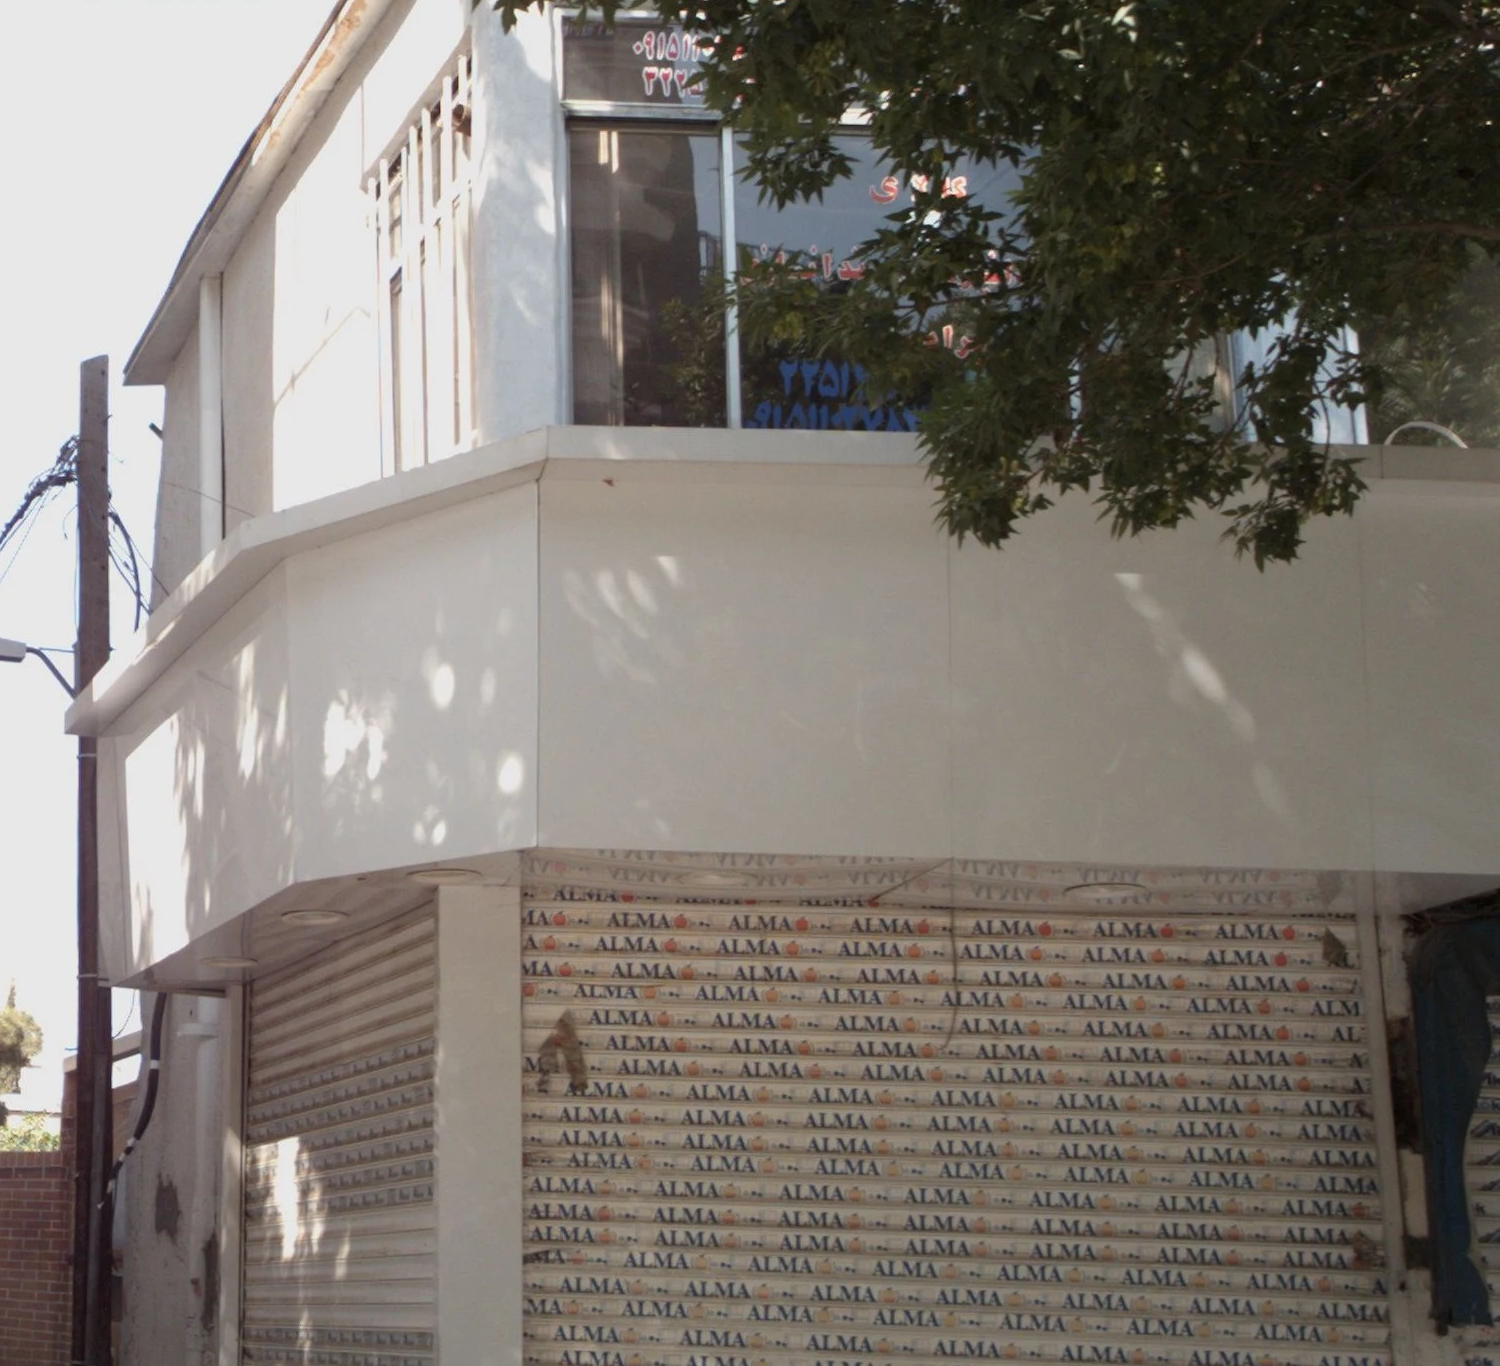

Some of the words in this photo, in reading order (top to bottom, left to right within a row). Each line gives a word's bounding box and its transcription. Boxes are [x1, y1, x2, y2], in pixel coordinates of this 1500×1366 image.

[971, 919, 1034, 936] ALMA
[1093, 921, 1156, 939] ALMA
[1215, 923, 1278, 940] ALMA
[596, 936, 658, 953] ALMA
[960, 943, 1023, 961] ALMA
[1082, 947, 1145, 963] ALMA
[612, 962, 676, 980] ALMA
[980, 970, 1044, 988] ALMA
[1102, 973, 1166, 991] ALMA
[1226, 975, 1290, 993] ALMA
[696, 985, 759, 1001] ALMA
[1064, 993, 1126, 1011] ALMA
[1187, 997, 1251, 1015] ALMA
[712, 1012, 776, 1030] ALMA
[836, 1015, 900, 1033] ALMA
[960, 1018, 1024, 1036] ALMA
[1084, 1021, 1148, 1039] ALMA
[853, 1041, 917, 1059] ALMA
[976, 1043, 1040, 1061] ALMA
[1100, 1046, 1164, 1064] ALMA
[619, 1059, 680, 1076] ALMA
[740, 1061, 802, 1079] ALMA
[862, 1064, 924, 1082] ALMA
[983, 1067, 1047, 1085] ALMA
[810, 1087, 874, 1105] ALMA
[932, 1090, 994, 1107] ALMA
[1054, 1093, 1118, 1110] ALMA
[1178, 1097, 1242, 1115] ALMA
[560, 1106, 622, 1124] ALMA
[682, 1109, 746, 1127] ALMA
[804, 1113, 868, 1131] ALMA
[928, 1115, 992, 1133] ALMA
[559, 1130, 623, 1148] ALMA
[684, 1133, 748, 1151] ALMA
[808, 1137, 872, 1155] ALMA
[1058, 1143, 1122, 1161] ALMA
[692, 1155, 756, 1174] ALMA
[816, 1158, 880, 1177] ALMA
[940, 1161, 1004, 1181] ALMA
[1064, 1166, 1128, 1185] ALMA
[656, 1181, 720, 1199] ALMA
[780, 1184, 844, 1202] ALMA
[905, 1187, 969, 1207] ALMA
[1030, 1191, 1094, 1209] ALMA
[654, 1207, 718, 1225] ALMA
[780, 1211, 844, 1229] ALMA
[905, 1215, 969, 1233] ALMA
[1031, 1219, 1095, 1237] ALMA
[656, 1230, 720, 1248] ALMA
[780, 1235, 844, 1253] ALMA
[906, 1239, 970, 1257] ALMA
[1158, 1247, 1222, 1265] ALMA
[748, 1255, 812, 1275] ALMA
[873, 1260, 937, 1279] ALMA
[998, 1264, 1062, 1283] ALMA
[1122, 1269, 1186, 1287] ALMA
[560, 1277, 624, 1295] ALMA
[686, 1281, 750, 1299] ALMA
[812, 1285, 876, 1303] ALMA
[1190, 1298, 1254, 1316] ALMA
[748, 1305, 812, 1323] ALMA
[1127, 1318, 1193, 1338] ALMA
[1255, 1323, 1322, 1343] ALMA
[936, 1341, 1000, 1359] ALMA
[1062, 1345, 1126, 1363] ALMA
